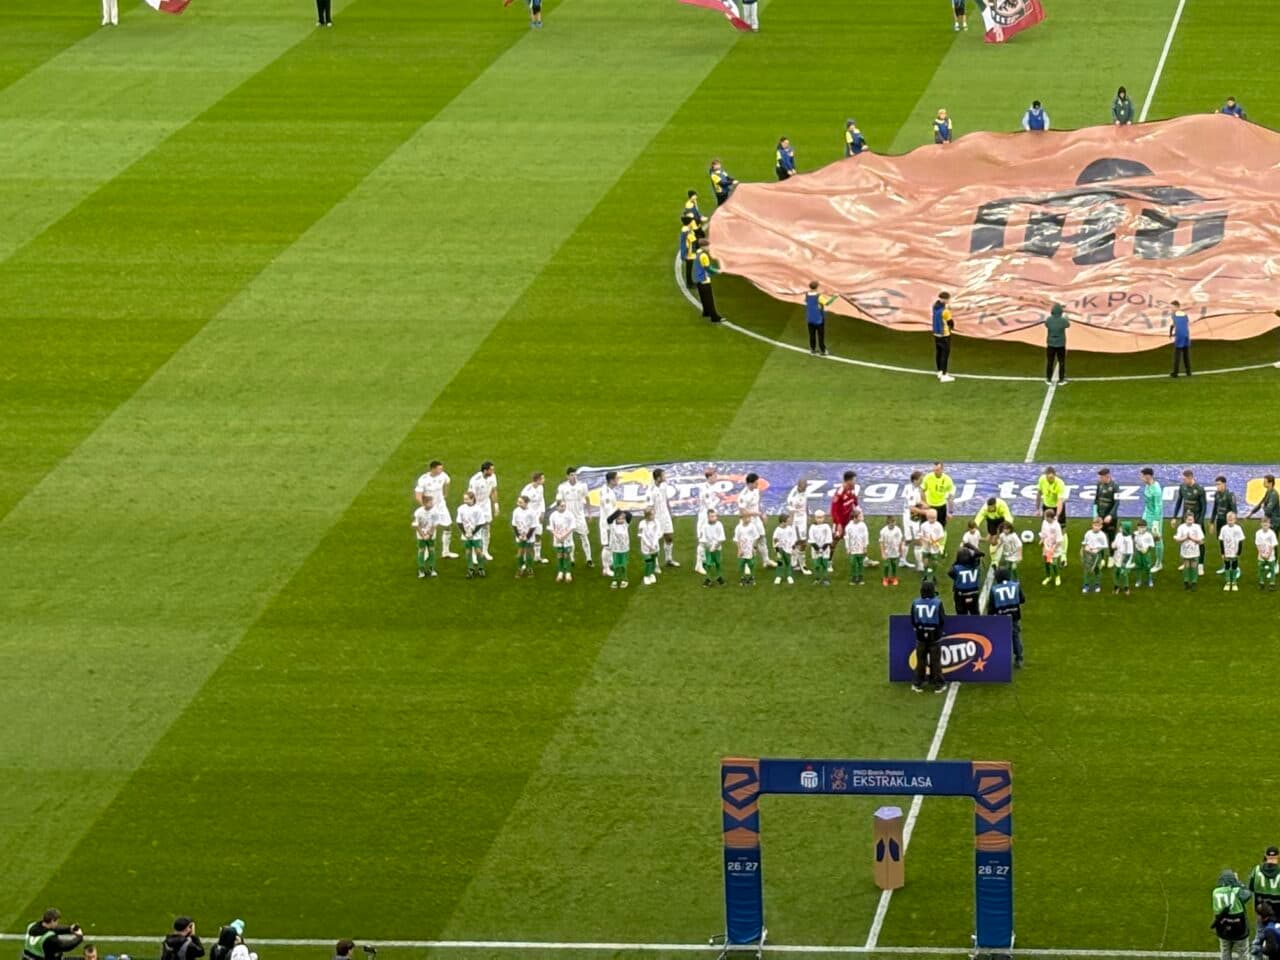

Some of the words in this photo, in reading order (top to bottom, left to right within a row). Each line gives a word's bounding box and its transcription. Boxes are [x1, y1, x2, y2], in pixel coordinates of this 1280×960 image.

[959, 569, 978, 584] TV
[996, 586, 1016, 601] TV
[916, 604, 936, 618] TV
[853, 775, 933, 788] EKSTRAKLASA
